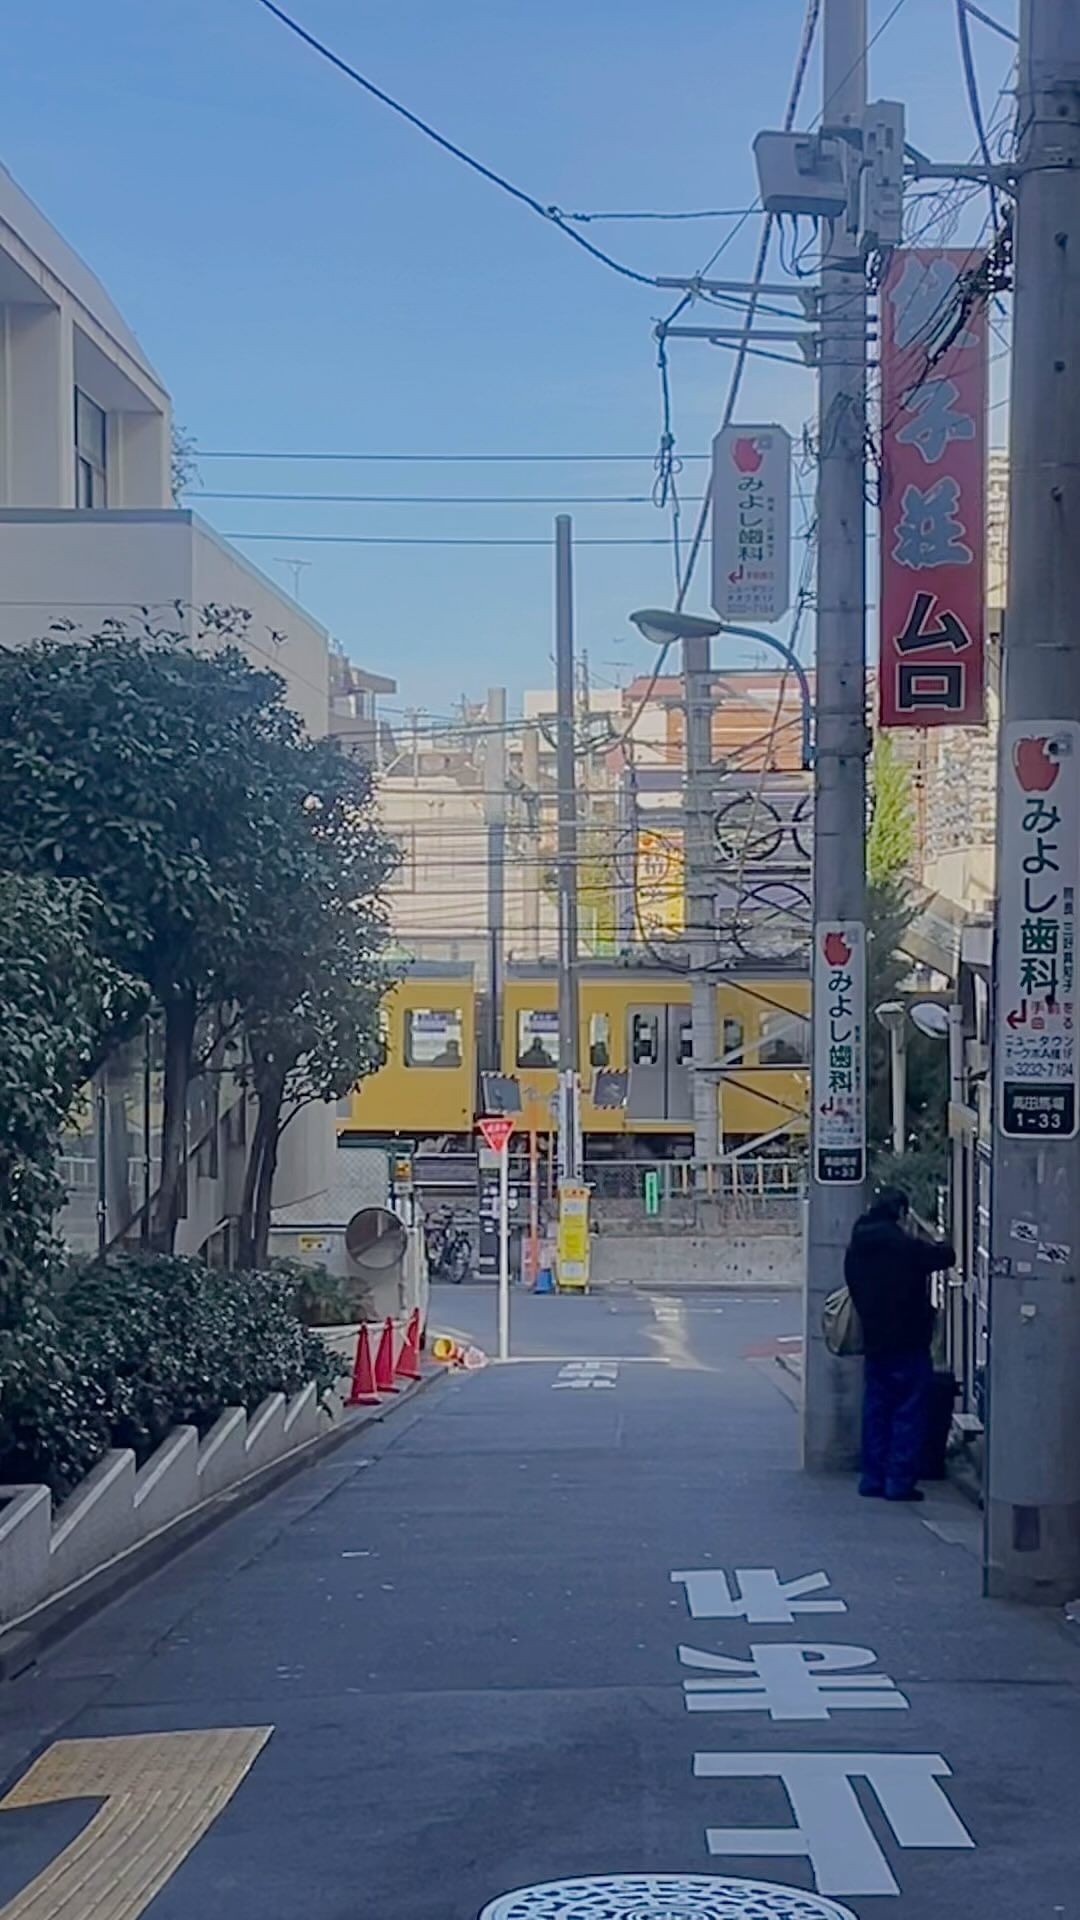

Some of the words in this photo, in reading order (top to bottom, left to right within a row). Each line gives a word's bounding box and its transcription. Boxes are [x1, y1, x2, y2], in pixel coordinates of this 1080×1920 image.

[738, 476, 763, 561] みよし歯科
[1021, 799, 1060, 996] みよし歯科
[828, 970, 852, 1093] みよし歯科
[1016, 1112, 1061, 1128] 1-33
